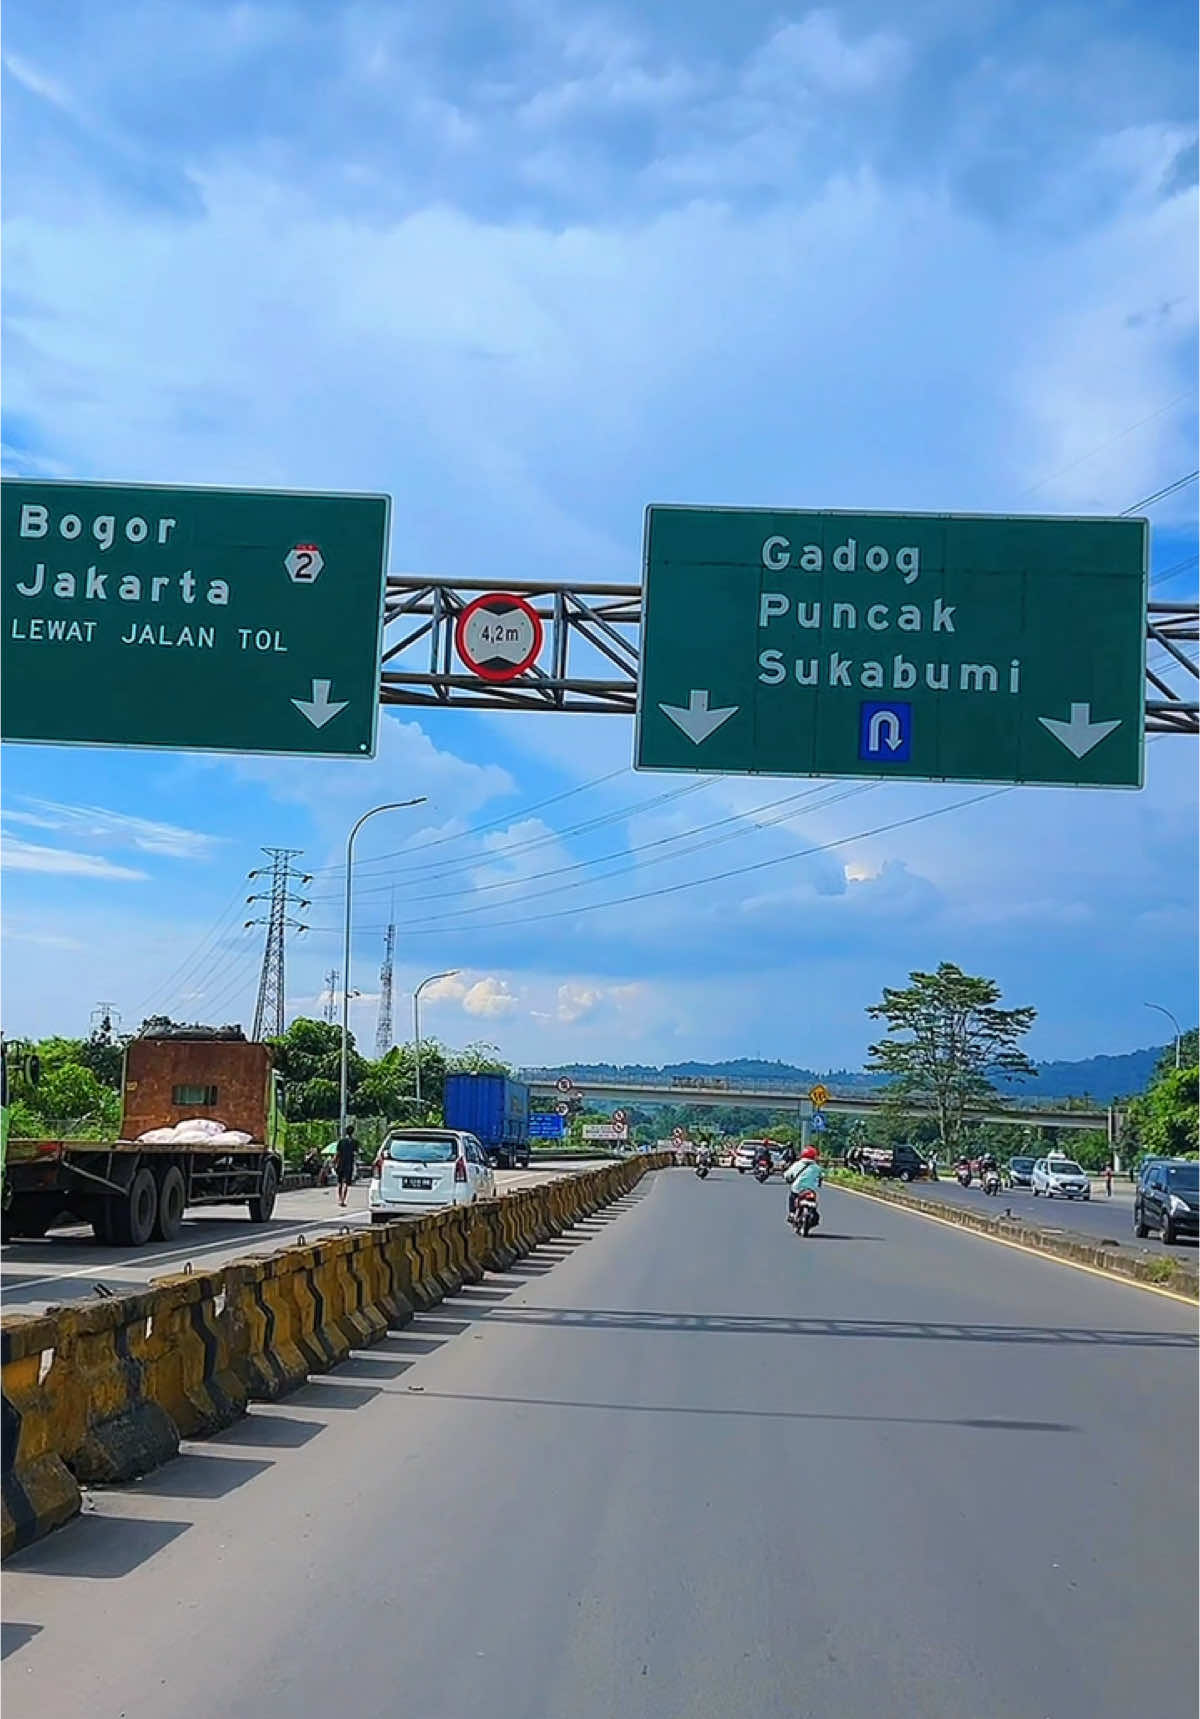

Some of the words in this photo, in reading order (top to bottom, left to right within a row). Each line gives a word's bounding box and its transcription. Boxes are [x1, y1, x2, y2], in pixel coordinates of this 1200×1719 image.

[20, 504, 177, 550] Bogor
[295, 552, 313, 579] 2
[762, 535, 919, 584] Gadog
[16, 563, 229, 605] Jakarta
[760, 593, 957, 632] Puncak
[11, 618, 97, 642] LEWAT
[121, 623, 215, 648] JALAN
[238, 628, 287, 652] TOL
[758, 650, 1021, 693] Sukabumi
